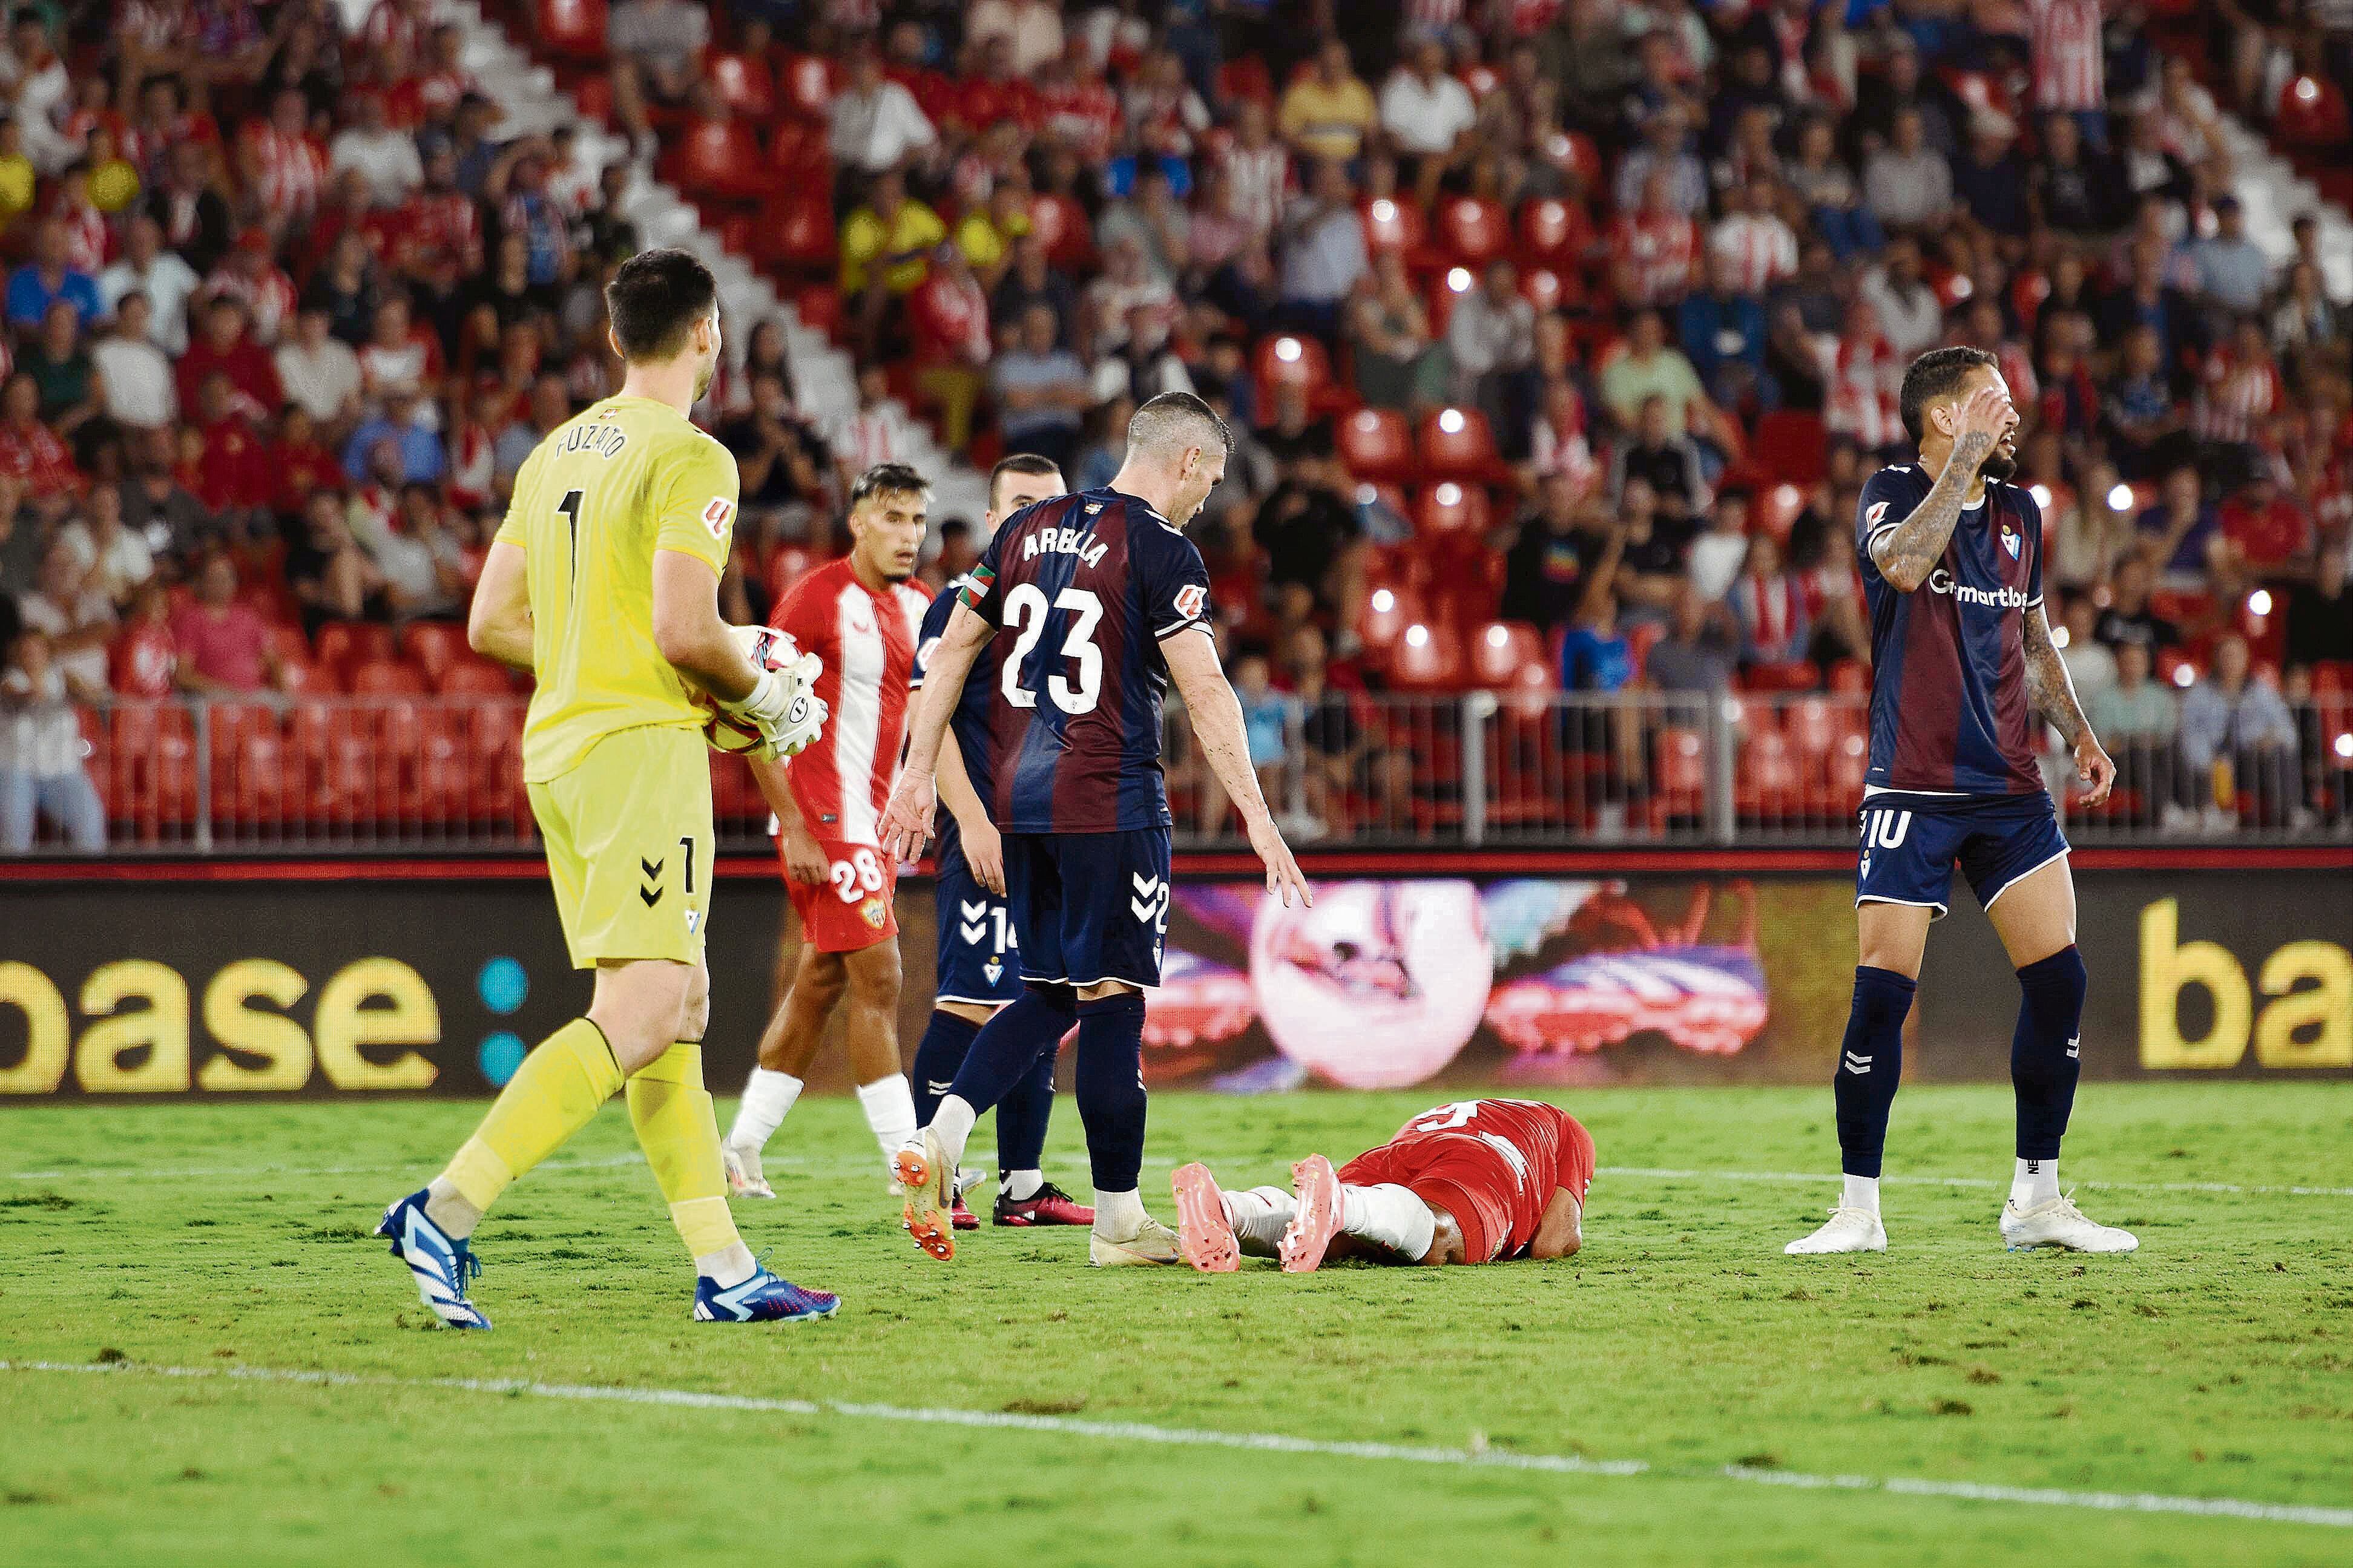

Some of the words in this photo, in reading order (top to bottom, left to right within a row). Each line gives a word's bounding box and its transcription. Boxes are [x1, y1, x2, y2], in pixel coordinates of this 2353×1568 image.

[556, 425, 626, 459] FUZATO
[557, 490, 584, 612] 1
[1023, 527, 1109, 569] ARBLLA
[1001, 582, 1104, 715] 23
[679, 836, 695, 894] 1
[829, 848, 883, 904] 28
[1155, 881, 1170, 934] 2
[2139, 897, 2353, 1070] ba
